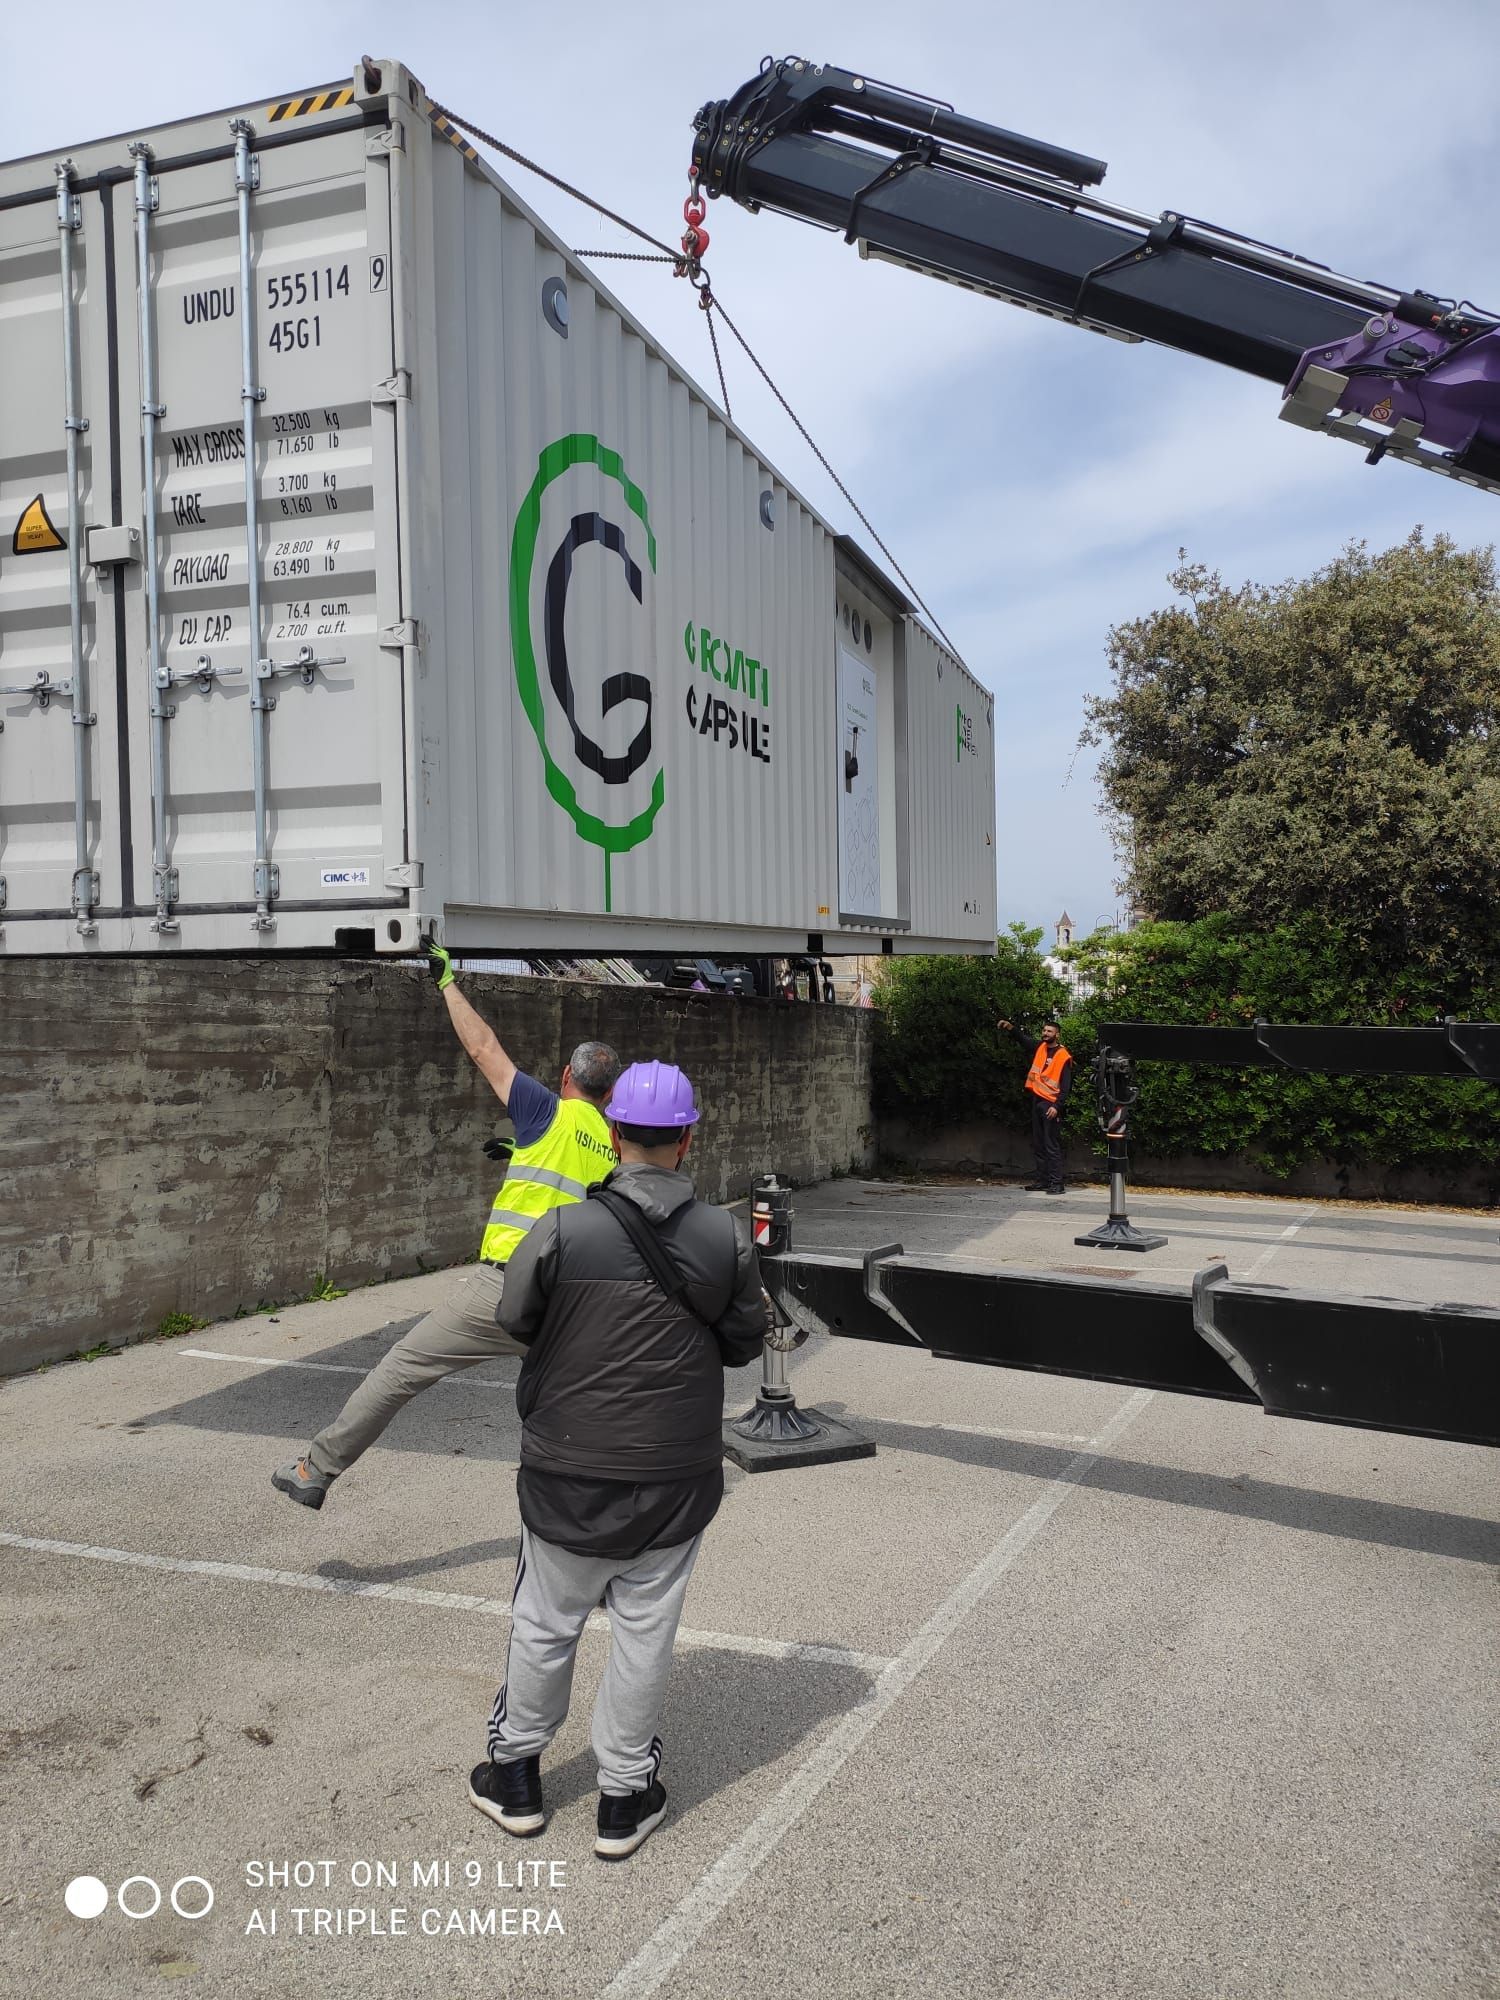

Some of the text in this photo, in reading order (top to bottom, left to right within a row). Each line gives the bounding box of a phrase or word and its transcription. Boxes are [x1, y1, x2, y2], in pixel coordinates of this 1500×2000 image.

[183, 256, 386, 325] UNDU 555114 9
[268, 315, 322, 354] 45G1
[171, 433, 204, 469] MAX
[203, 427, 246, 463] GROSS
[323, 409, 341, 430] kg
[276, 431, 340, 456] 71.650 lb
[170, 493, 207, 527] TARE
[323, 471, 337, 492] kg
[325, 493, 338, 511] lb
[172, 553, 230, 586] PAYLOAD
[326, 537, 341, 555] kg
[324, 555, 336, 572] lb
[178, 602, 351, 646] CU. CAP. 76.4 cu.m.
[323, 873, 350, 883] CIMC
